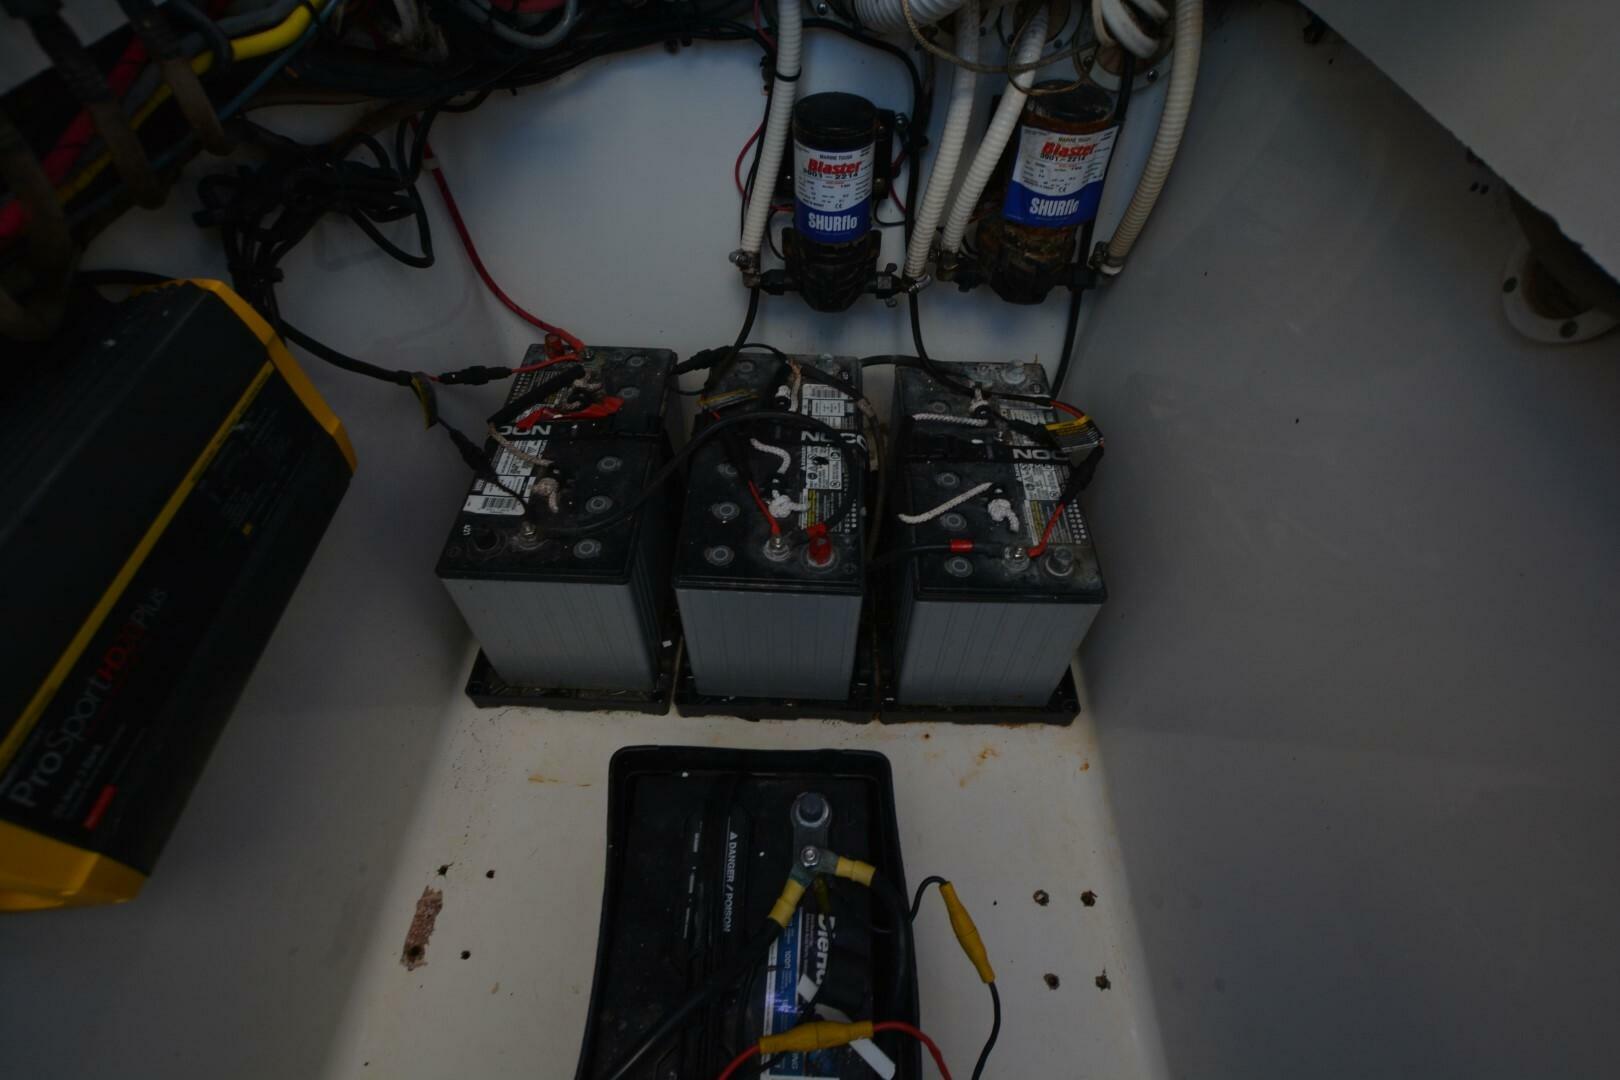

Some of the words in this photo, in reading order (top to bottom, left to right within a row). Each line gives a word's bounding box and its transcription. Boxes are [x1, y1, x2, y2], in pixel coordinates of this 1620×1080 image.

[1042, 141, 1097, 158] Blaster
[808, 158, 862, 174] Blaster
[808, 212, 858, 232] SHURflo
[727, 842, 738, 883] DANGER
[722, 893, 734, 933] POISON
